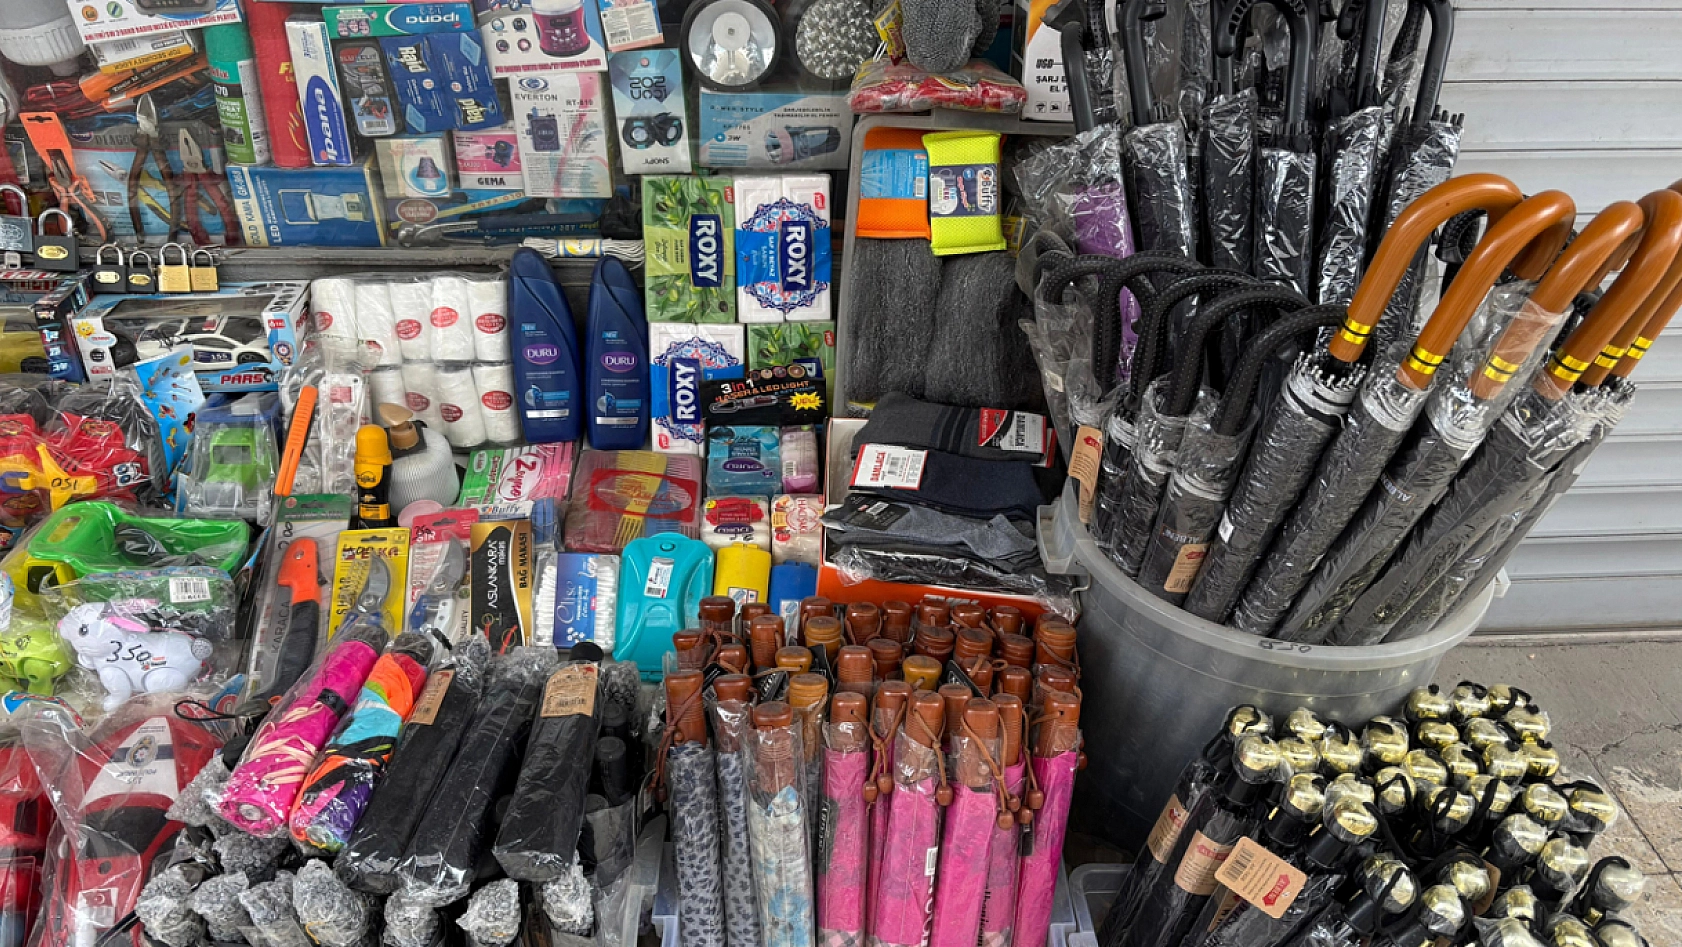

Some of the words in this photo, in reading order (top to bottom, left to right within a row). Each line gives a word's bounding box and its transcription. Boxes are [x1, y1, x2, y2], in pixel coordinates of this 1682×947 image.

[405, 12, 461, 28] ipana
[514, 93, 558, 101] EVERTON
[314, 88, 337, 161] ipana
[642, 157, 670, 165] SNOPY
[477, 177, 506, 186] GEMA
[981, 180, 993, 212] Buffy
[270, 225, 282, 243] LED
[695, 219, 718, 282] ROXY
[786, 225, 806, 286] ROXY
[527, 348, 557, 359] DURU
[605, 355, 634, 366] DURU
[220, 373, 264, 385] PARS
[721, 383, 731, 394] 3
[675, 363, 696, 419] ROXY
[519, 532, 528, 568] MAKASI
[487, 540, 498, 608] ASLANKARA
[519, 569, 528, 589] BAĞ
[272, 601, 290, 651] KARACA
[106, 640, 152, 662] 350
